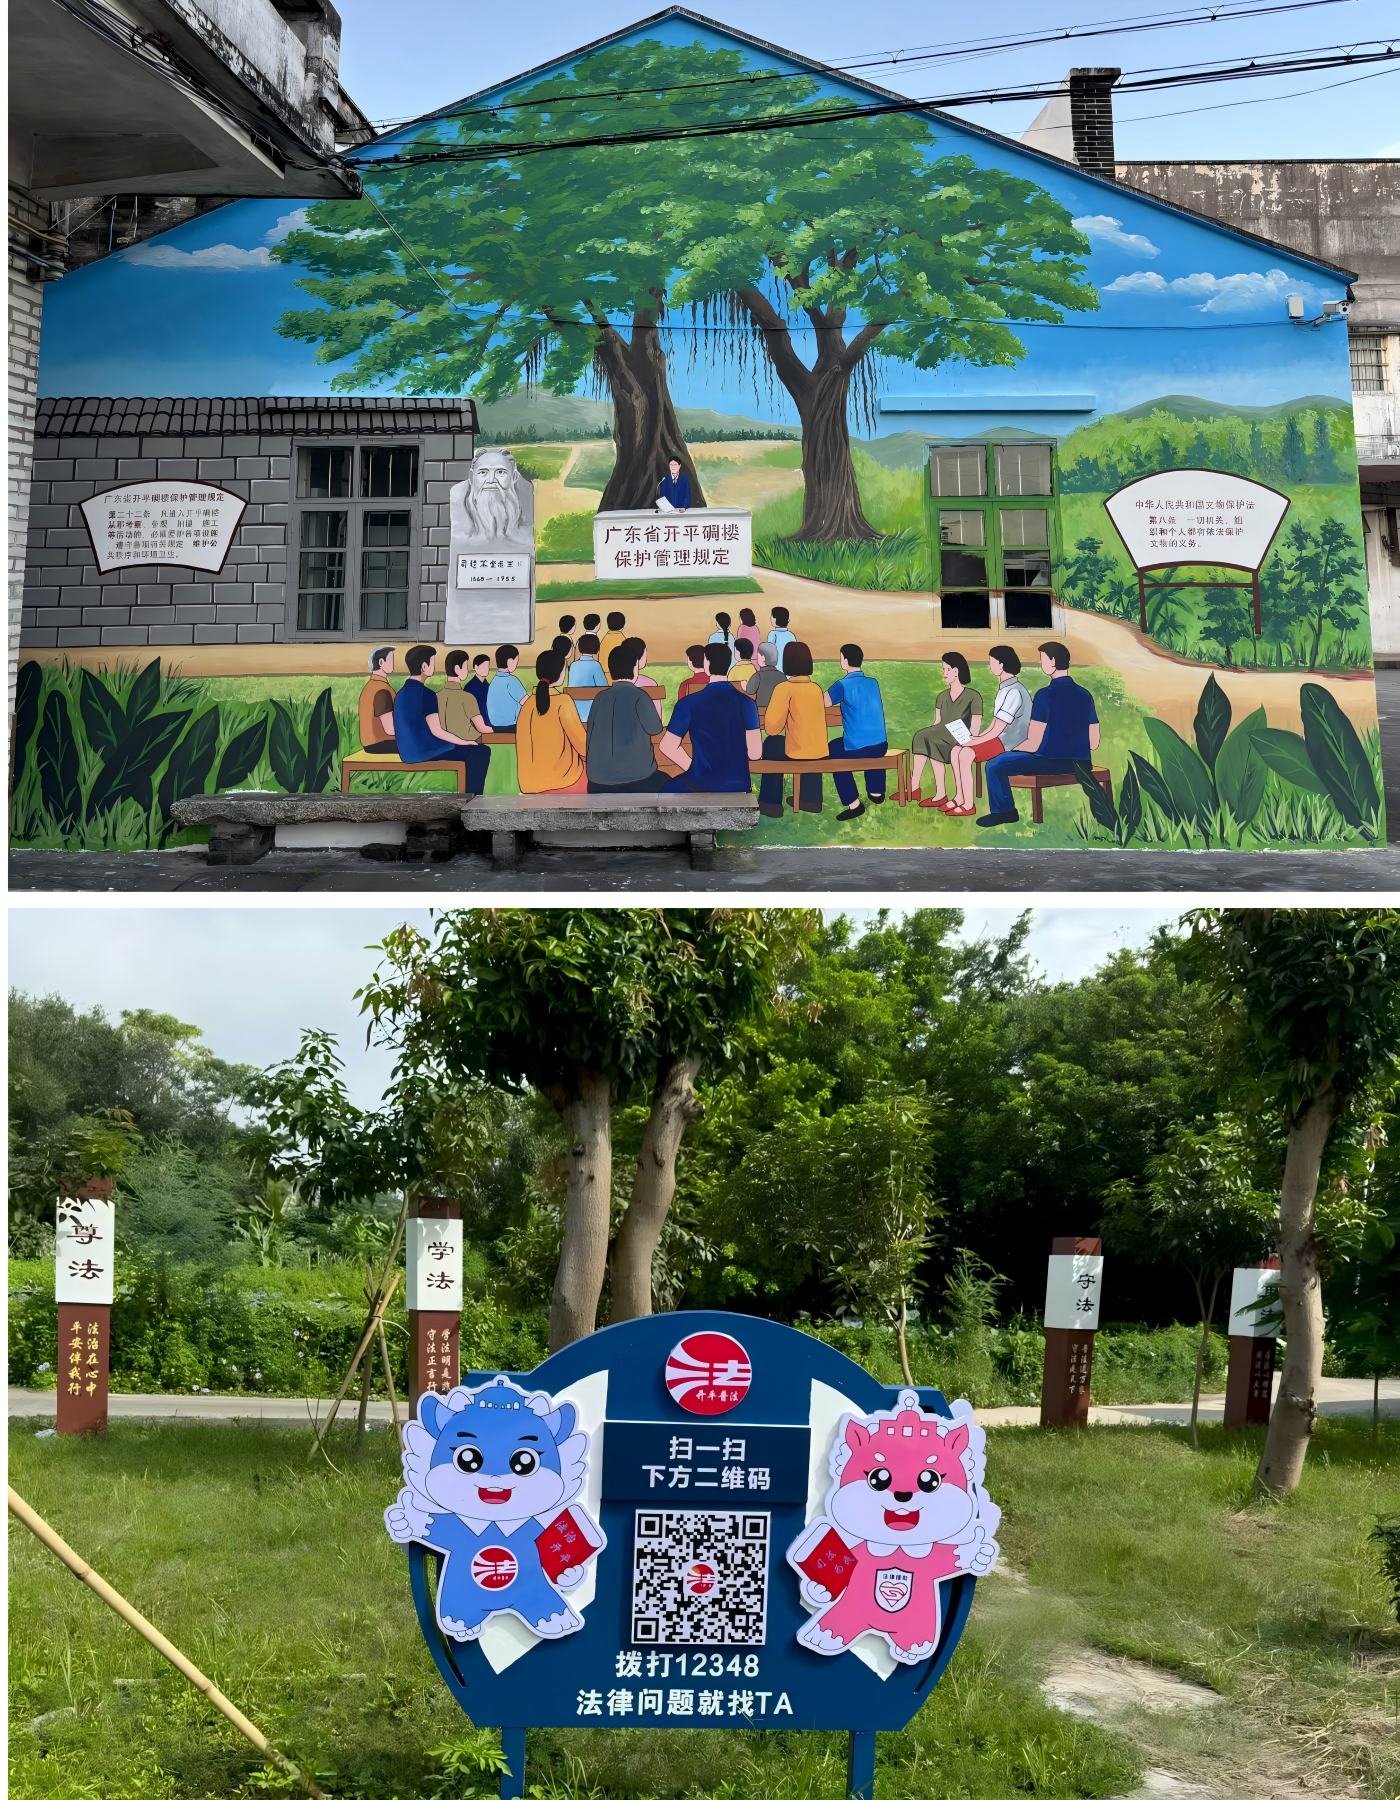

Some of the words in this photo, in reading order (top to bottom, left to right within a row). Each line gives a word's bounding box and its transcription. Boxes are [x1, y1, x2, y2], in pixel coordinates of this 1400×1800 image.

[1135, 499, 1255, 510] 中华人民共和国文物保护法
[604, 522, 740, 544] 广东省开平碉楼
[614, 548, 731, 568] 保护管理规定
[67, 1223, 104, 1280] 尊法
[426, 1241, 456, 1290] 学法
[1076, 1273, 1096, 1312] 守法
[67, 1320, 84, 1397] 平安伴我行
[85, 1322, 100, 1398] 法治在心中
[695, 1389, 739, 1402] 开平普法
[668, 1436, 747, 1462] 扫一扫
[641, 1465, 772, 1491] 下方二维码
[554, 1520, 577, 1544] 法治
[615, 1650, 761, 1679] 拨打12348
[575, 1689, 794, 1716] 法律问题就找TA
